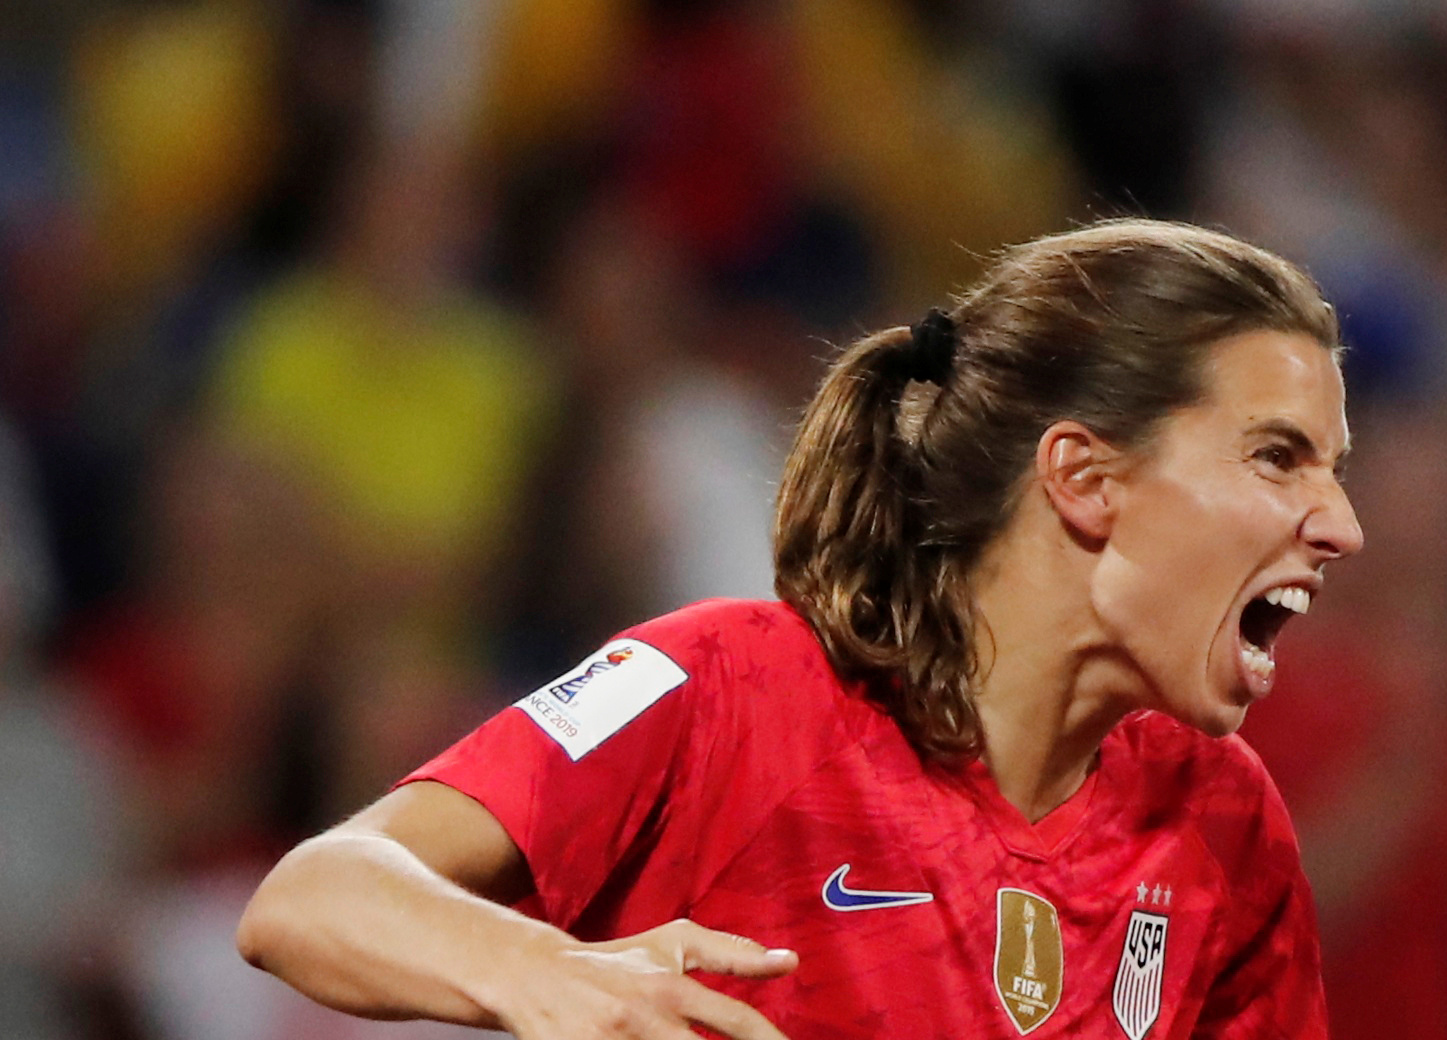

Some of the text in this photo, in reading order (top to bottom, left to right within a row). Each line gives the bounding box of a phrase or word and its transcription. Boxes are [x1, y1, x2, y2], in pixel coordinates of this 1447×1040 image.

[549, 713, 578, 738] 2019
[1129, 919, 1164, 969] USA
[1013, 976, 1044, 1001] FIFA
